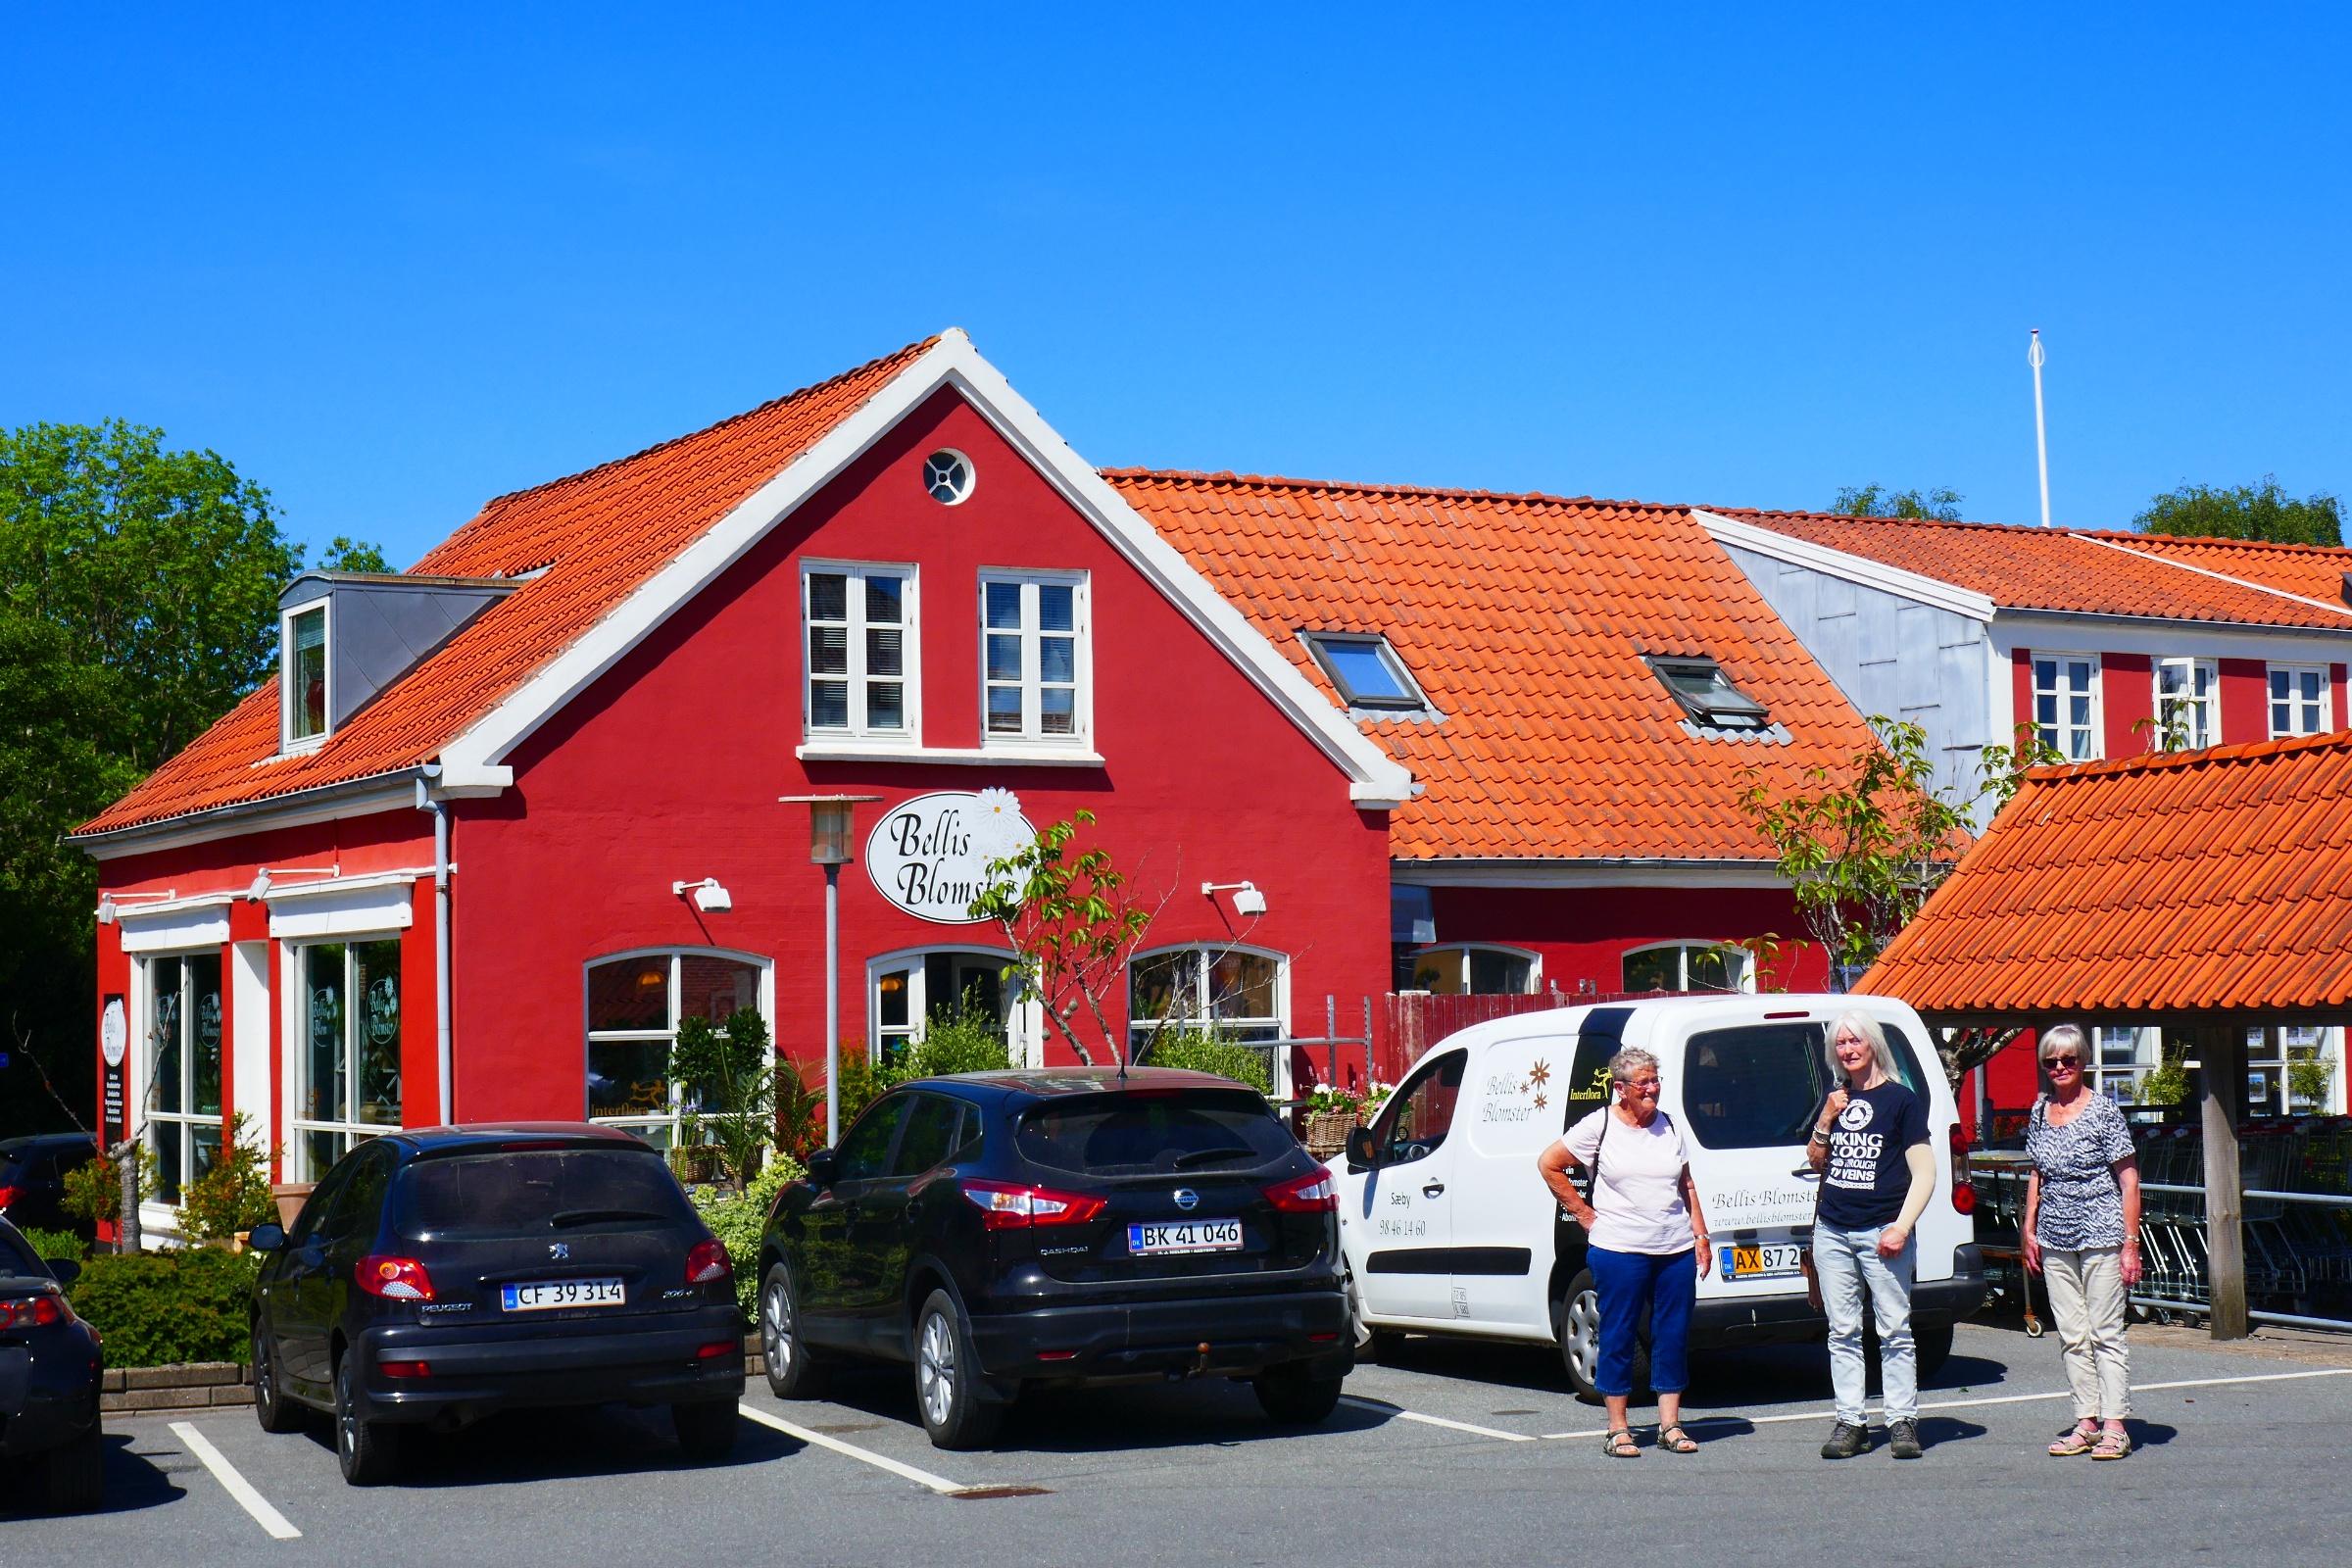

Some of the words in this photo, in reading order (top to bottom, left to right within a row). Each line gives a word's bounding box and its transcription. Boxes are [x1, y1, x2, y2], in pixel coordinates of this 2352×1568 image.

[890, 809, 971, 857] Bellis
[897, 858, 1015, 906] Blomstr
[1487, 1072, 1518, 1096] Bellis
[1569, 1088, 1601, 1101] Interflora
[590, 1102, 649, 1116] Interflora
[1483, 1100, 1533, 1122] Blomster
[1841, 1169, 1876, 1182] VEINS
[1391, 1191, 1411, 1208] Sæby
[1712, 1189, 1756, 1209] Bellis
[1759, 1187, 1819, 1206] Blomste
[1714, 1210, 1814, 1227] www.bellisblomster.
[1144, 1226, 1170, 1247] BK
[1175, 1224, 1197, 1245] 41
[1203, 1222, 1239, 1243] 046
[1379, 1219, 1390, 1236] 98
[1392, 1219, 1401, 1236] 46
[1403, 1220, 1413, 1236] 14
[1415, 1219, 1426, 1237] 60
[1040, 1246, 1088, 1256] QASHQAI
[1736, 1250, 1760, 1270] AX
[1763, 1249, 1784, 1268] 87
[518, 1284, 546, 1304] CF
[553, 1283, 577, 1302] 39
[583, 1279, 621, 1300] 314
[662, 1290, 684, 1298] 206
[421, 1302, 472, 1313] PEUGEOT
